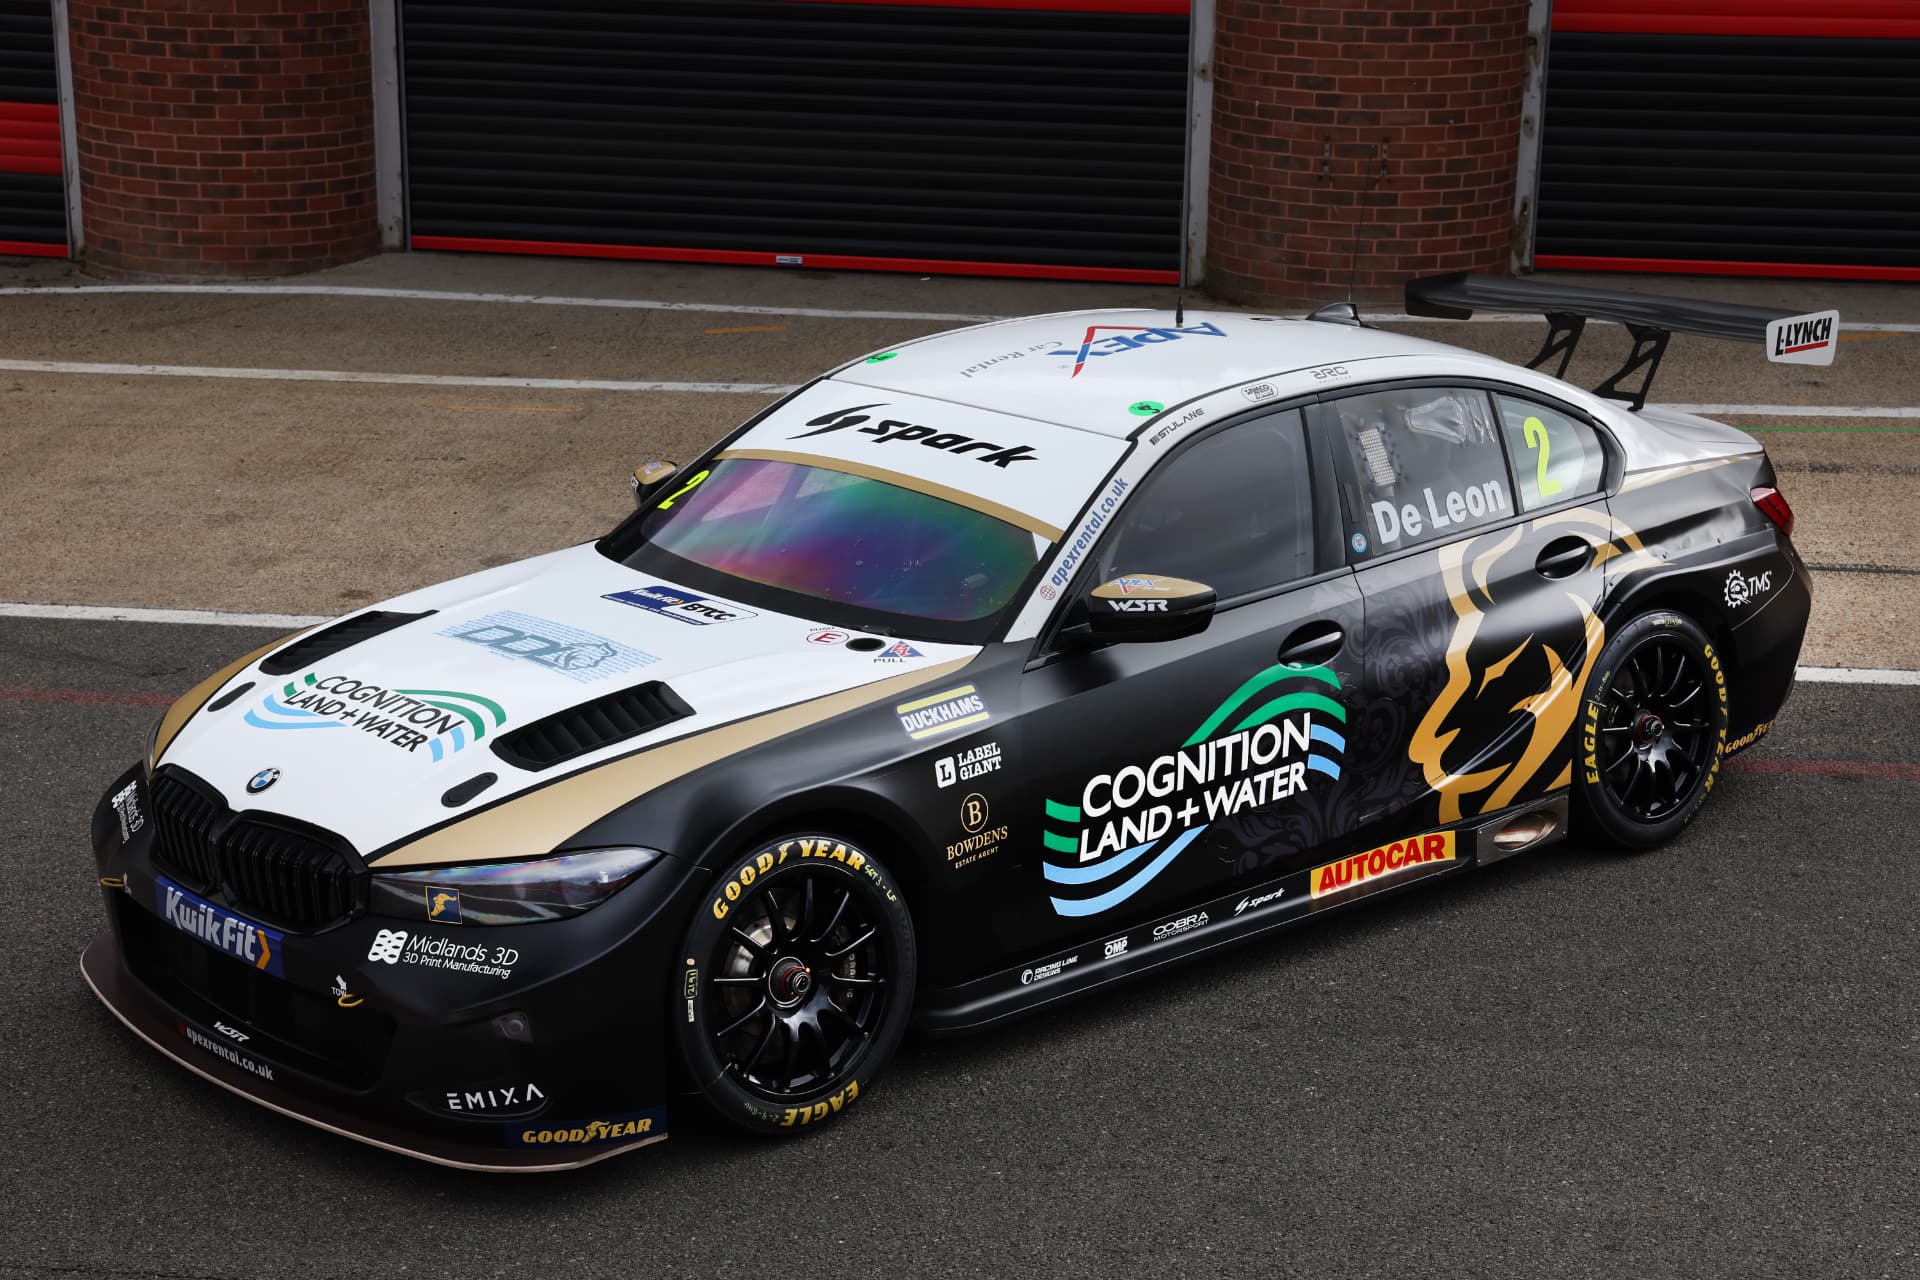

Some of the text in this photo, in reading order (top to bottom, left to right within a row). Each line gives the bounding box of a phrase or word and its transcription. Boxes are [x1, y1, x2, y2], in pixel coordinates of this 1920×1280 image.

[960, 341, 1063, 378] Car Rental
[1047, 322, 1227, 378] APEX
[857, 419, 1039, 468] spark
[1522, 416, 1562, 497] 2
[657, 470, 710, 510] 2
[1371, 480, 1506, 544] De Leon
[1051, 477, 1129, 587] apexrental.co.uk
[1748, 570, 1771, 597] TMS
[680, 603, 737, 621] BTCC
[1107, 600, 1169, 612] WSR
[814, 632, 843, 643] E
[315, 676, 465, 735] COGNITION
[900, 695, 984, 732] DUCKHAMS
[957, 743, 1000, 767] LABEL
[1584, 702, 1600, 784] EAGLE
[959, 756, 1002, 780] GIANT
[1082, 712, 1311, 817] COGNITION
[967, 800, 982, 826] B
[946, 826, 1008, 860] BOWDENS
[955, 846, 999, 869] ESTATE AGENT
[1319, 834, 1446, 894] AUTOCAR
[1153, 911, 1209, 935] COBRA
[1153, 920, 1209, 942] MOTORSPORT
[406, 934, 519, 966] Midlands 3D
[1104, 939, 1128, 956] OMP
[402, 952, 512, 980] 3D Print Manufacturing
[1033, 968, 1061, 981] DESIGNS
[1034, 955, 1078, 975] RACING LINE
[186, 1026, 274, 1081] apexrental.co.uk
[446, 1083, 545, 1110] EMIXA
[780, 1080, 860, 1127] EAGLE
